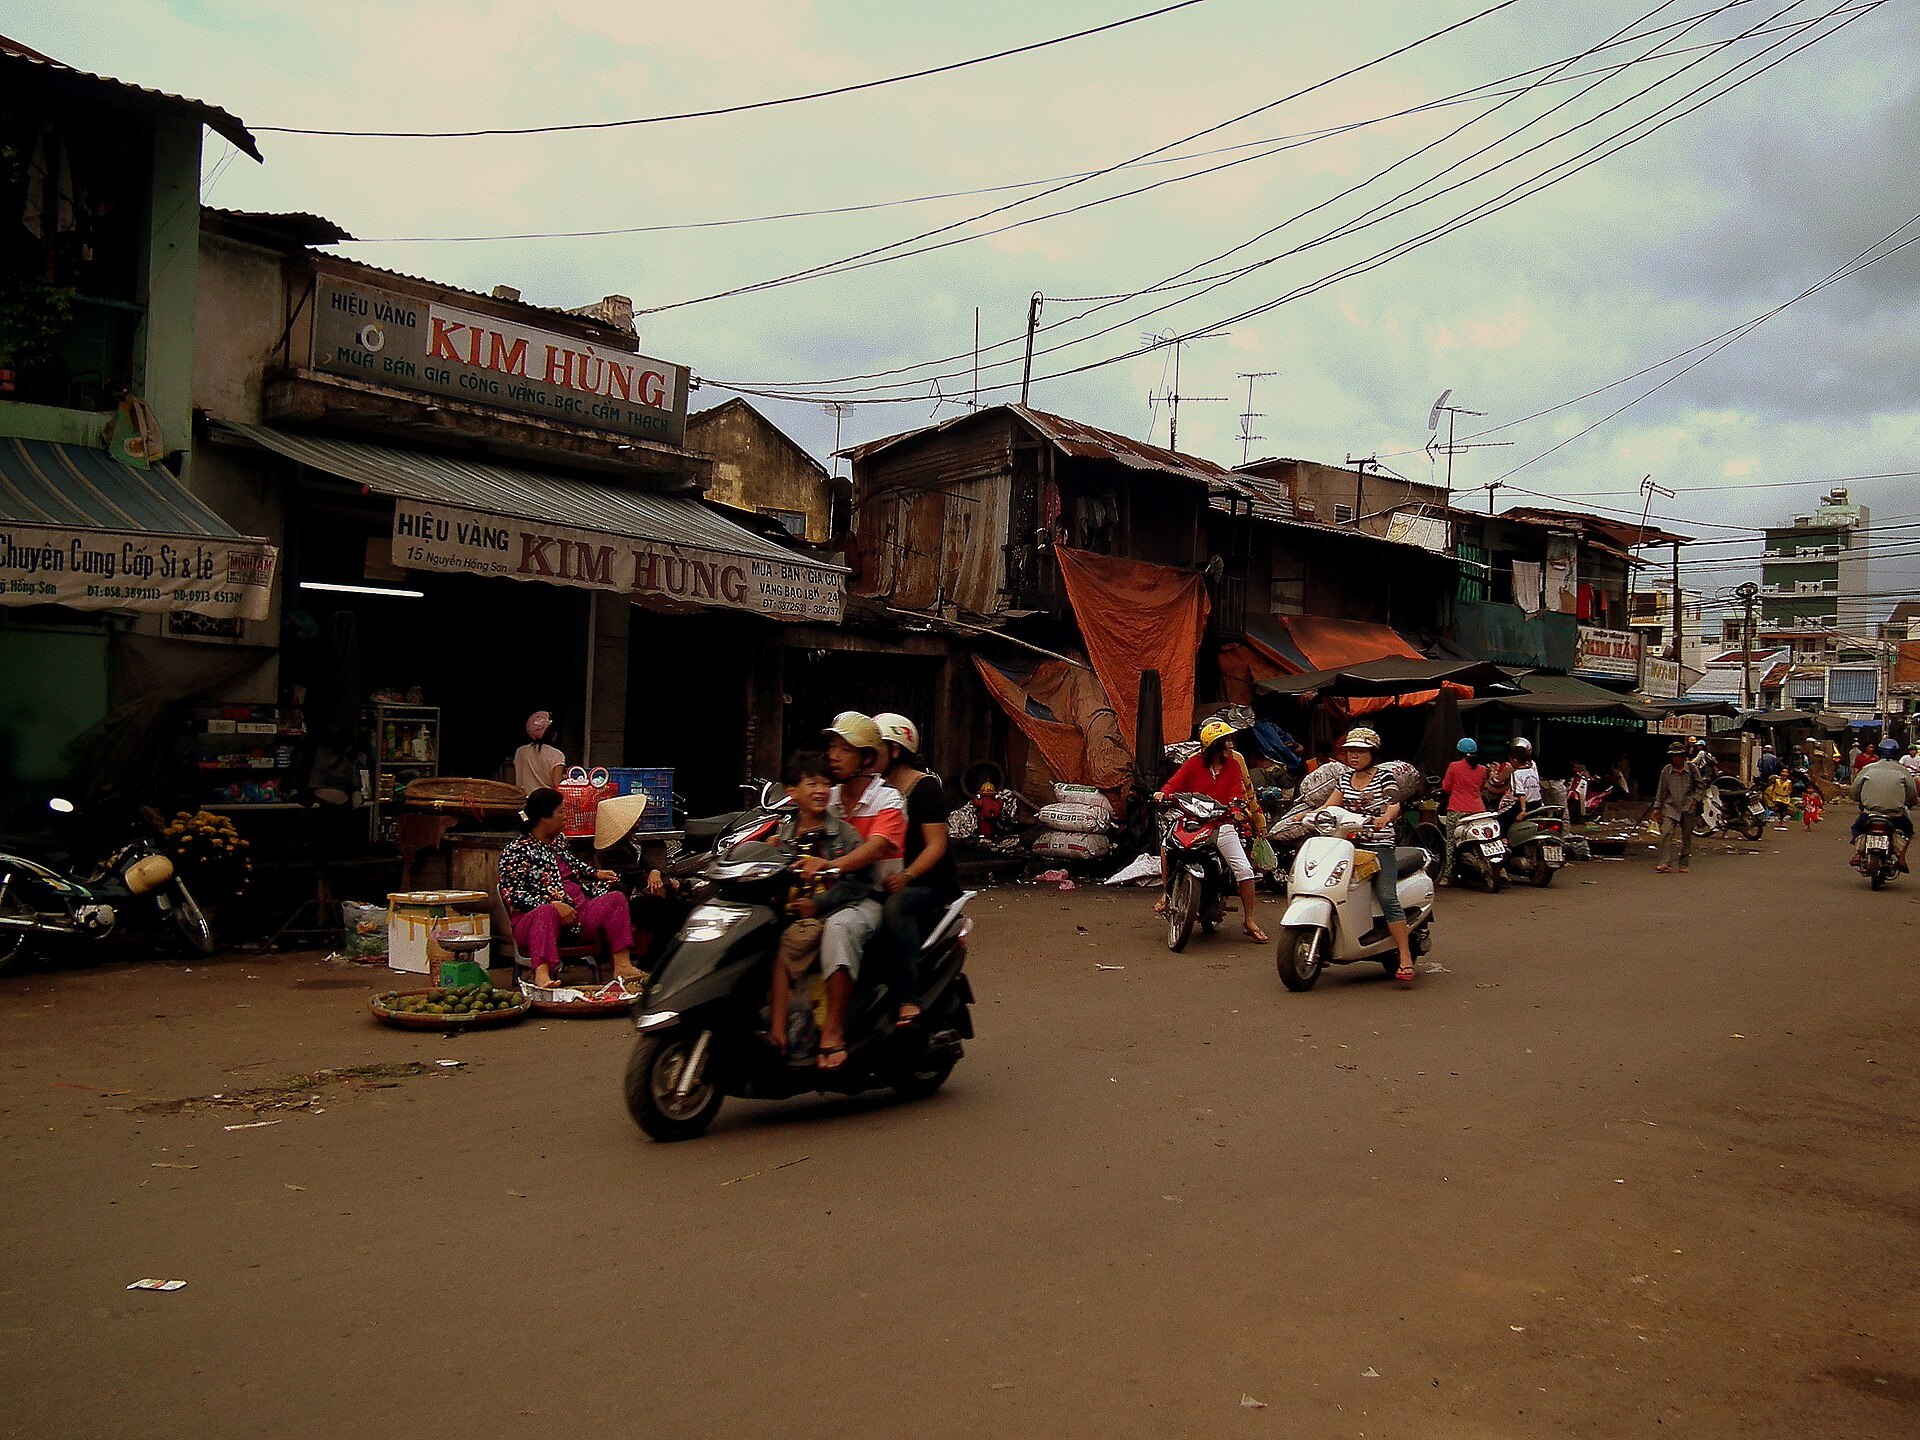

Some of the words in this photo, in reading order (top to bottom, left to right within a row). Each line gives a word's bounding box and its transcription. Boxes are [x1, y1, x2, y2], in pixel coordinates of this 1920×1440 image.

[331, 292, 368, 317] HIỆU
[374, 301, 417, 328] VÀNG
[337, 347, 375, 368] MUA
[424, 367, 451, 385] GIA
[459, 373, 499, 395] CÔNG
[426, 317, 530, 377] KIM
[542, 346, 666, 409] HÙNG
[398, 511, 449, 544] HIỆU
[457, 518, 509, 551] VÀNG
[70, 537, 116, 579] Cung
[121, 541, 154, 580] Cấp
[181, 557, 192, 578] &
[407, 546, 424, 561] 15
[515, 531, 618, 585] KIM
[631, 544, 748, 603] HÙNG
[751, 561, 773, 577] MUA
[807, 569, 824, 585] GIA
[759, 580, 783, 596] VÀNG
[784, 585, 802, 601] BẠC
